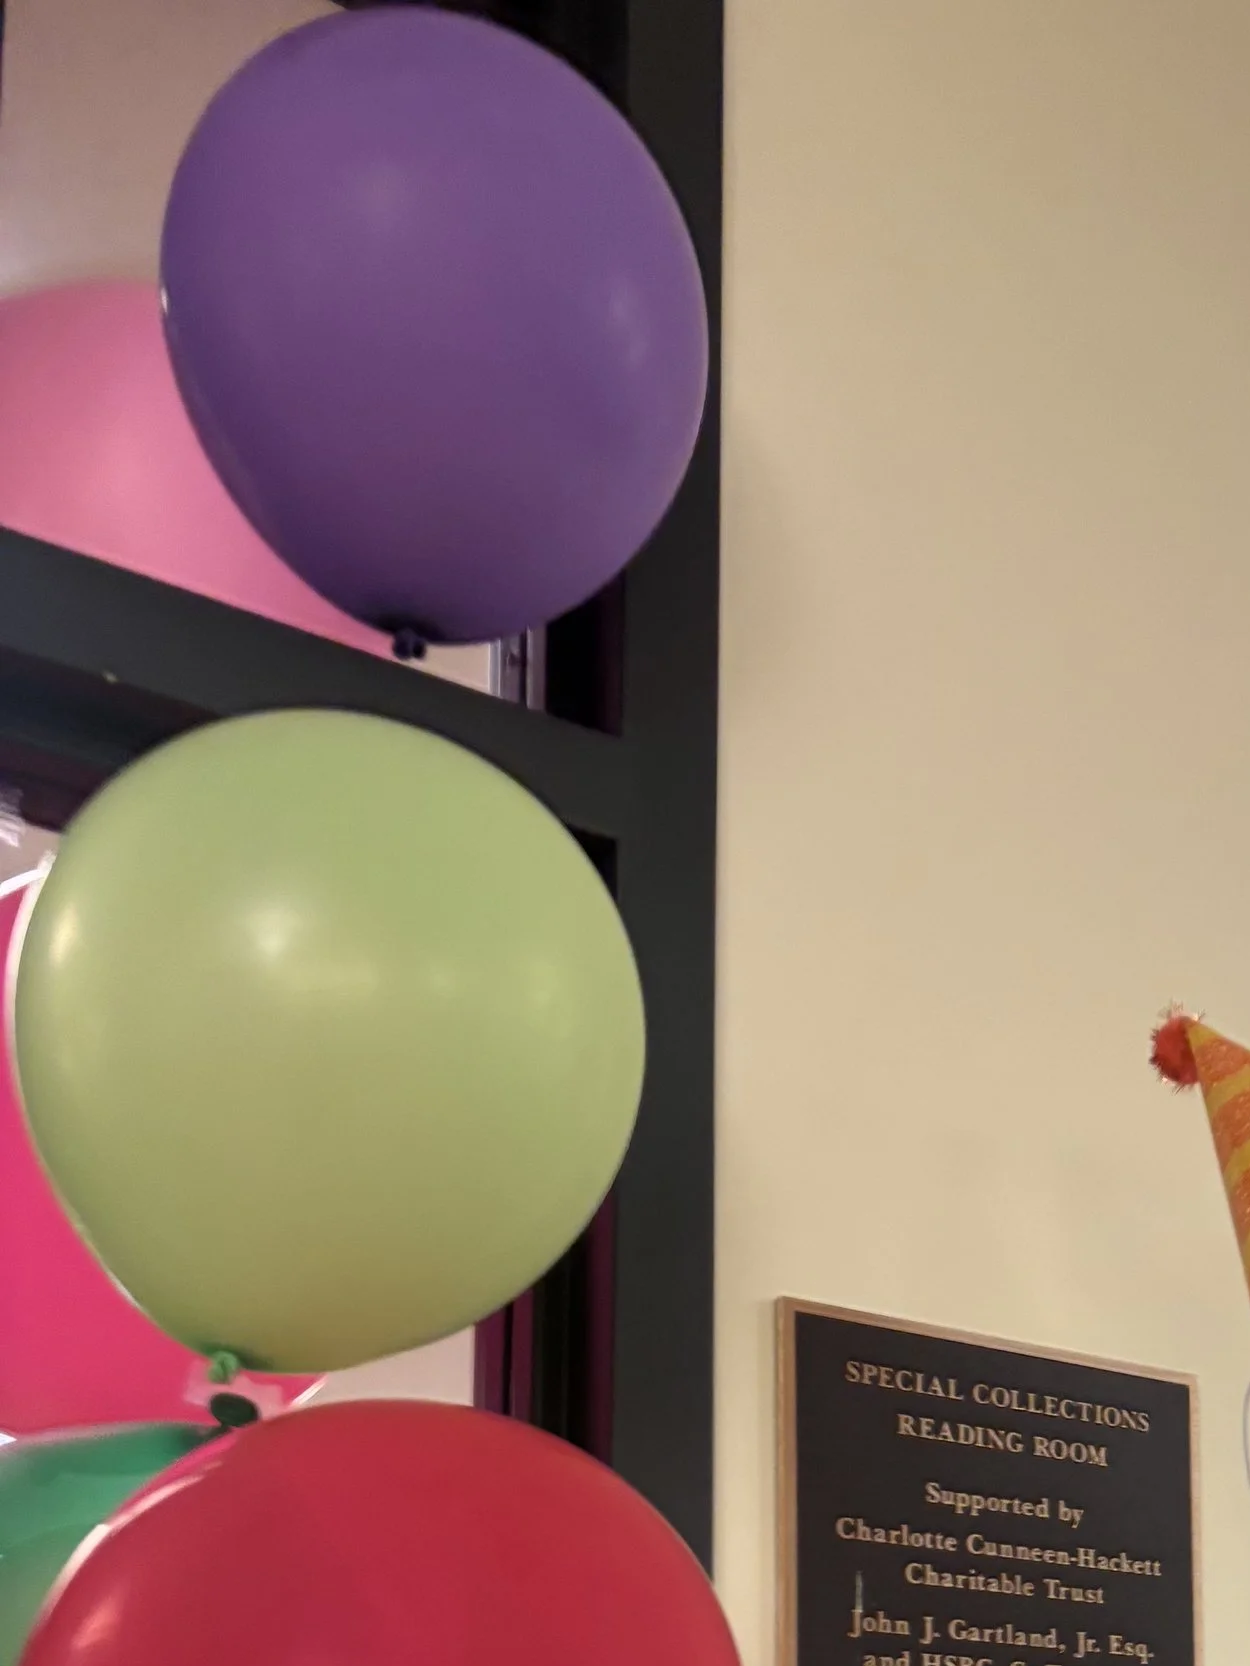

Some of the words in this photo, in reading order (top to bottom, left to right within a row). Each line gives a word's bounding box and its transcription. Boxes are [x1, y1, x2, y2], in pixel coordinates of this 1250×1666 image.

[845, 1361, 964, 1401] SPECIAL
[972, 1384, 1151, 1433] COLLECTIONS
[896, 1414, 1024, 1454] READING
[1032, 1436, 1109, 1467] ROOM
[925, 1482, 1049, 1519] Supported
[1058, 1500, 1084, 1528] by
[835, 1517, 958, 1553] Charlotte
[966, 1534, 1162, 1577] Cunneen-Hackett
[904, 1563, 1035, 1597] Charitable
[1043, 1579, 1104, 1605] Trust
[847, 1608, 911, 1638] John
[920, 1616, 941, 1645] J.
[948, 1619, 1066, 1653] Gartland,
[1073, 1632, 1100, 1658] Jr.
[1108, 1635, 1155, 1665] Esq.
